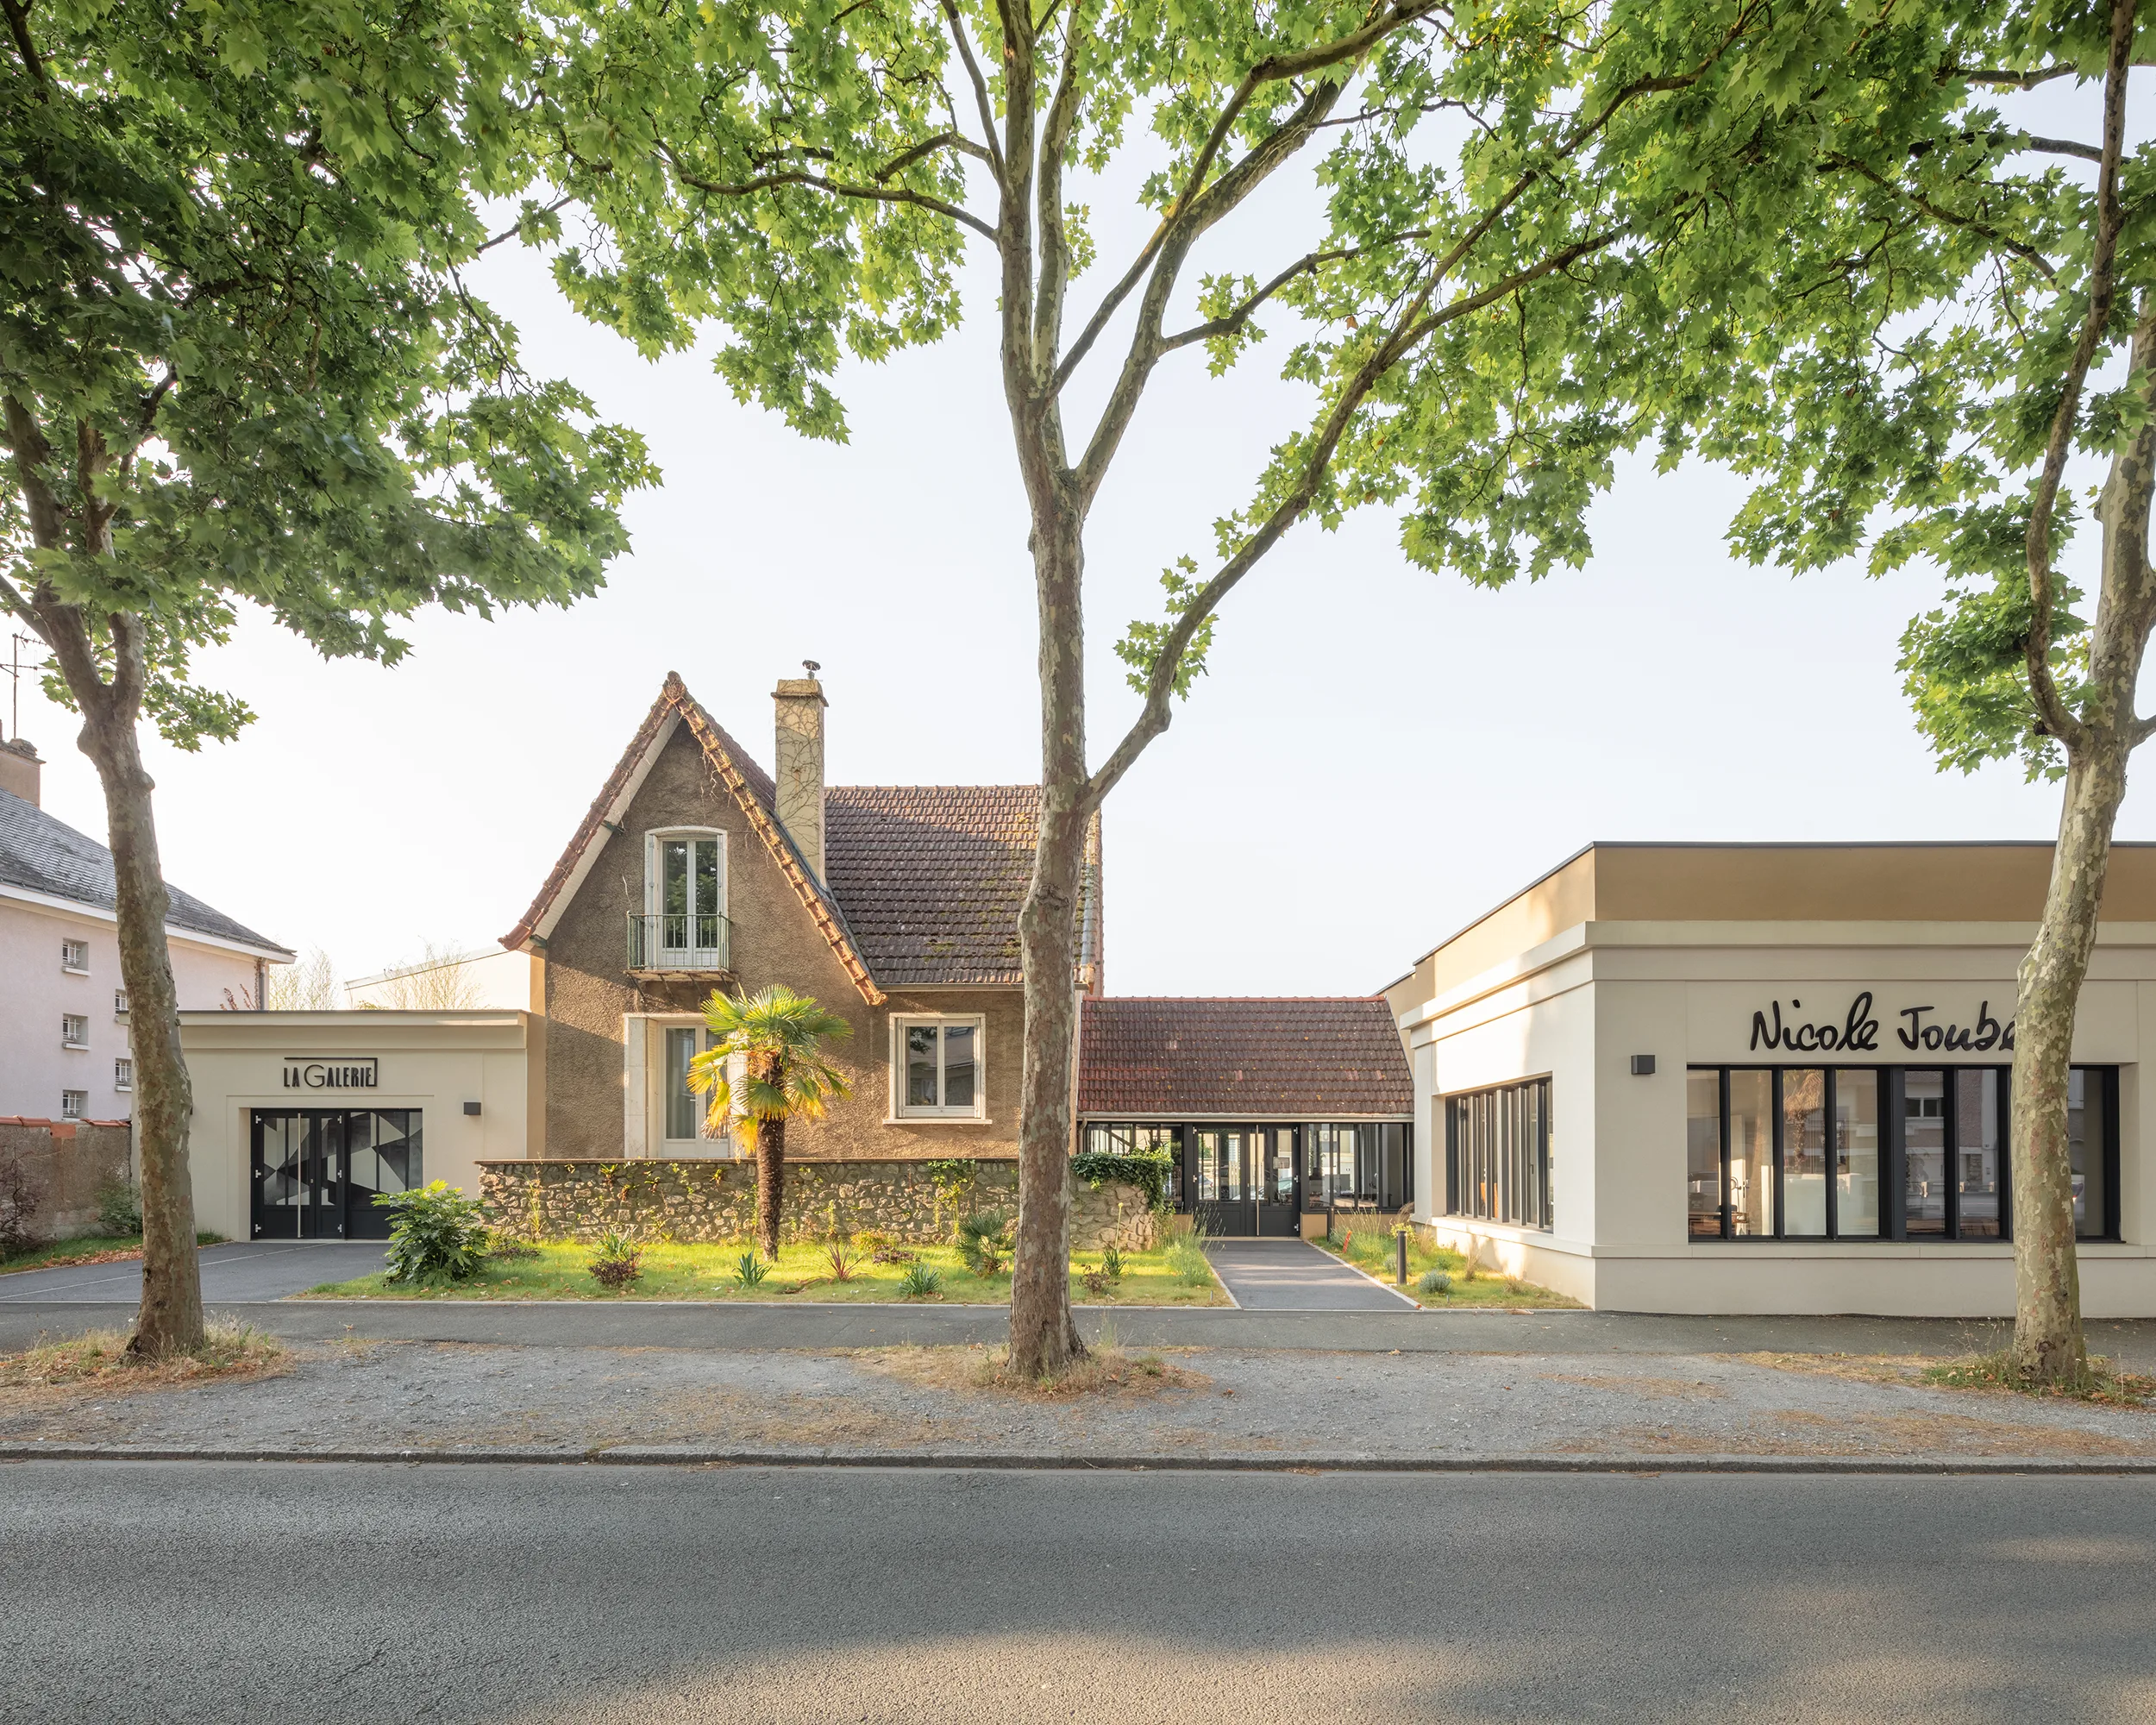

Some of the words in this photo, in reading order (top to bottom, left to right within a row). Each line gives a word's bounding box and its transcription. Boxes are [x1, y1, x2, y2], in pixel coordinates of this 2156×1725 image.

[1750, 991, 1879, 1051] Nicole
[284, 1067, 300, 1088] LA
[304, 1063, 378, 1088] GALERIE
